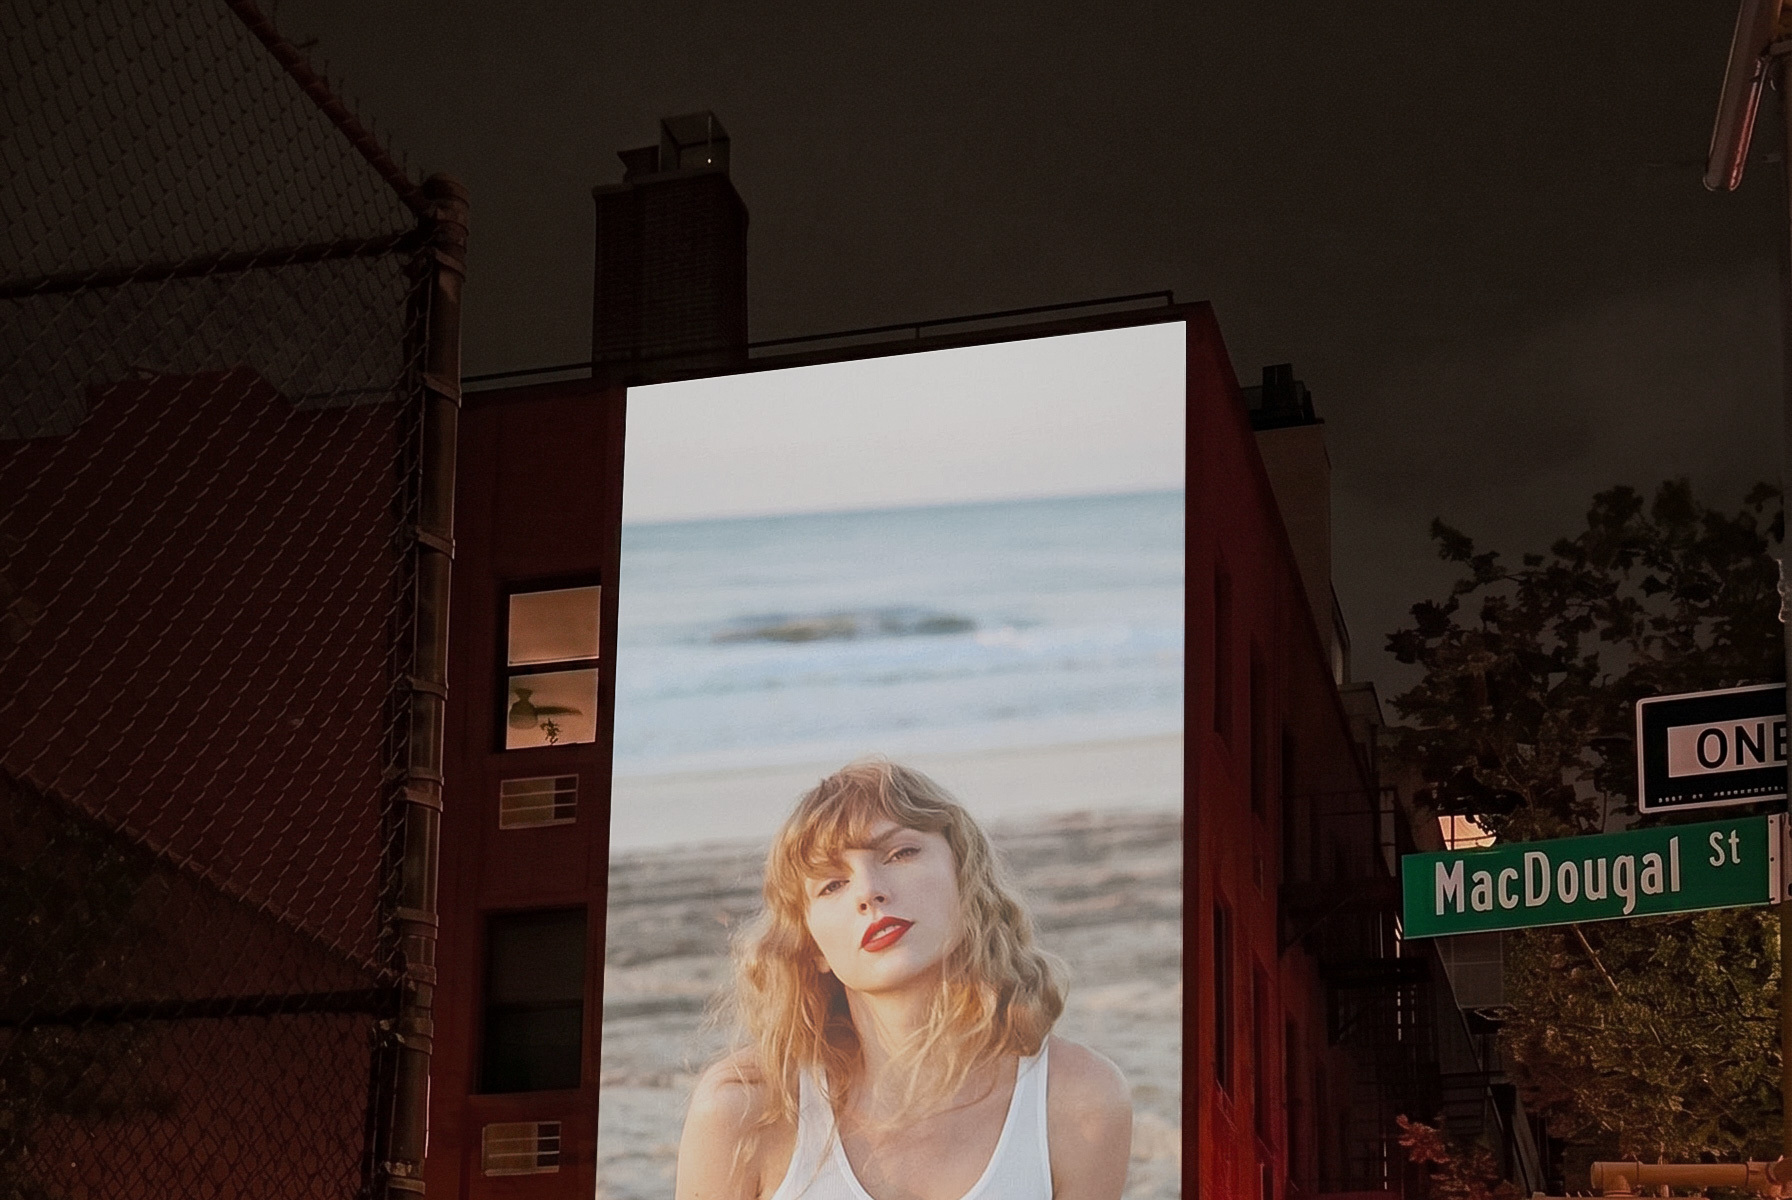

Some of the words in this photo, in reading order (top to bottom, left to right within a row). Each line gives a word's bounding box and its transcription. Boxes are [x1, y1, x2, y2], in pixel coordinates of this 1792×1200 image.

[1697, 720, 1787, 769] ONE
[1434, 836, 1681, 915] MacDougal
[1708, 829, 1741, 868] St
